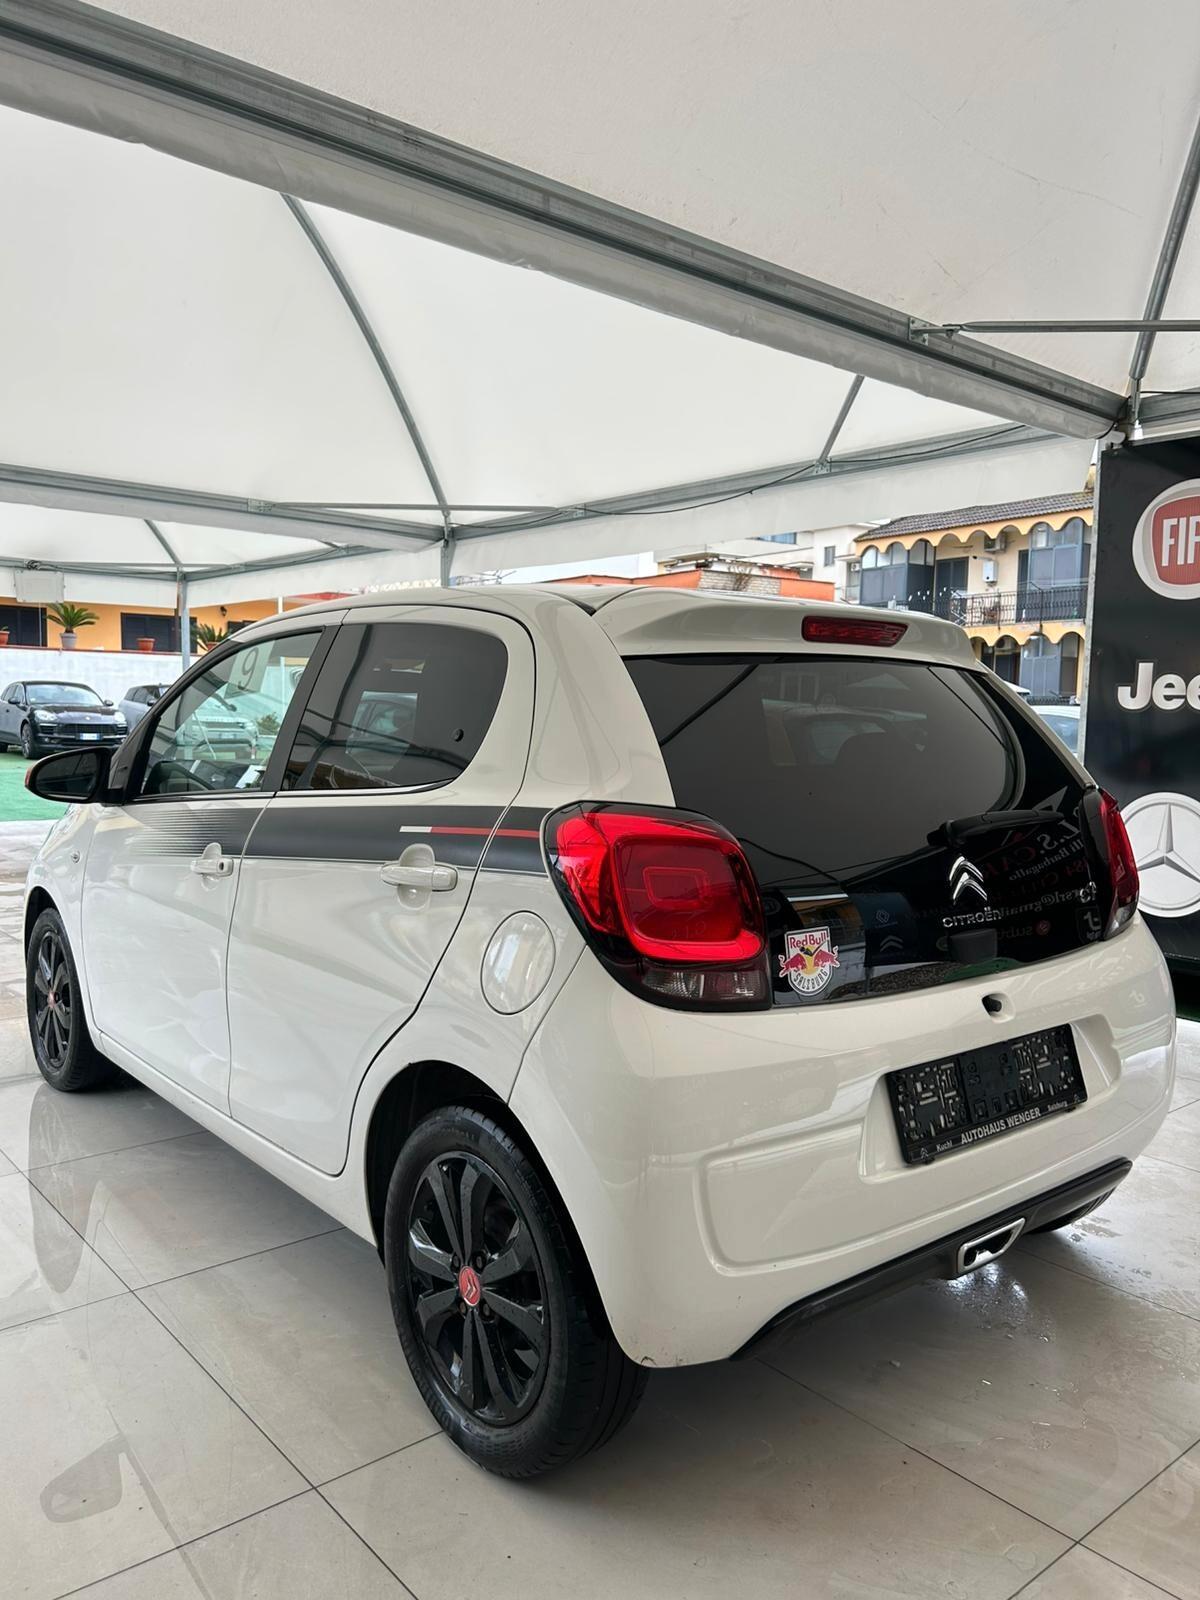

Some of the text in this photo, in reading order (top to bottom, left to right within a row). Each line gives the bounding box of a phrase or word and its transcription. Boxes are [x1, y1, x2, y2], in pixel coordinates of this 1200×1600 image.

[789, 931, 828, 949] Red Bull
[793, 968, 829, 991] SALZBURG
[961, 1119, 1007, 1144] AUTOHAUS
[1006, 1107, 1041, 1128] WENGER
